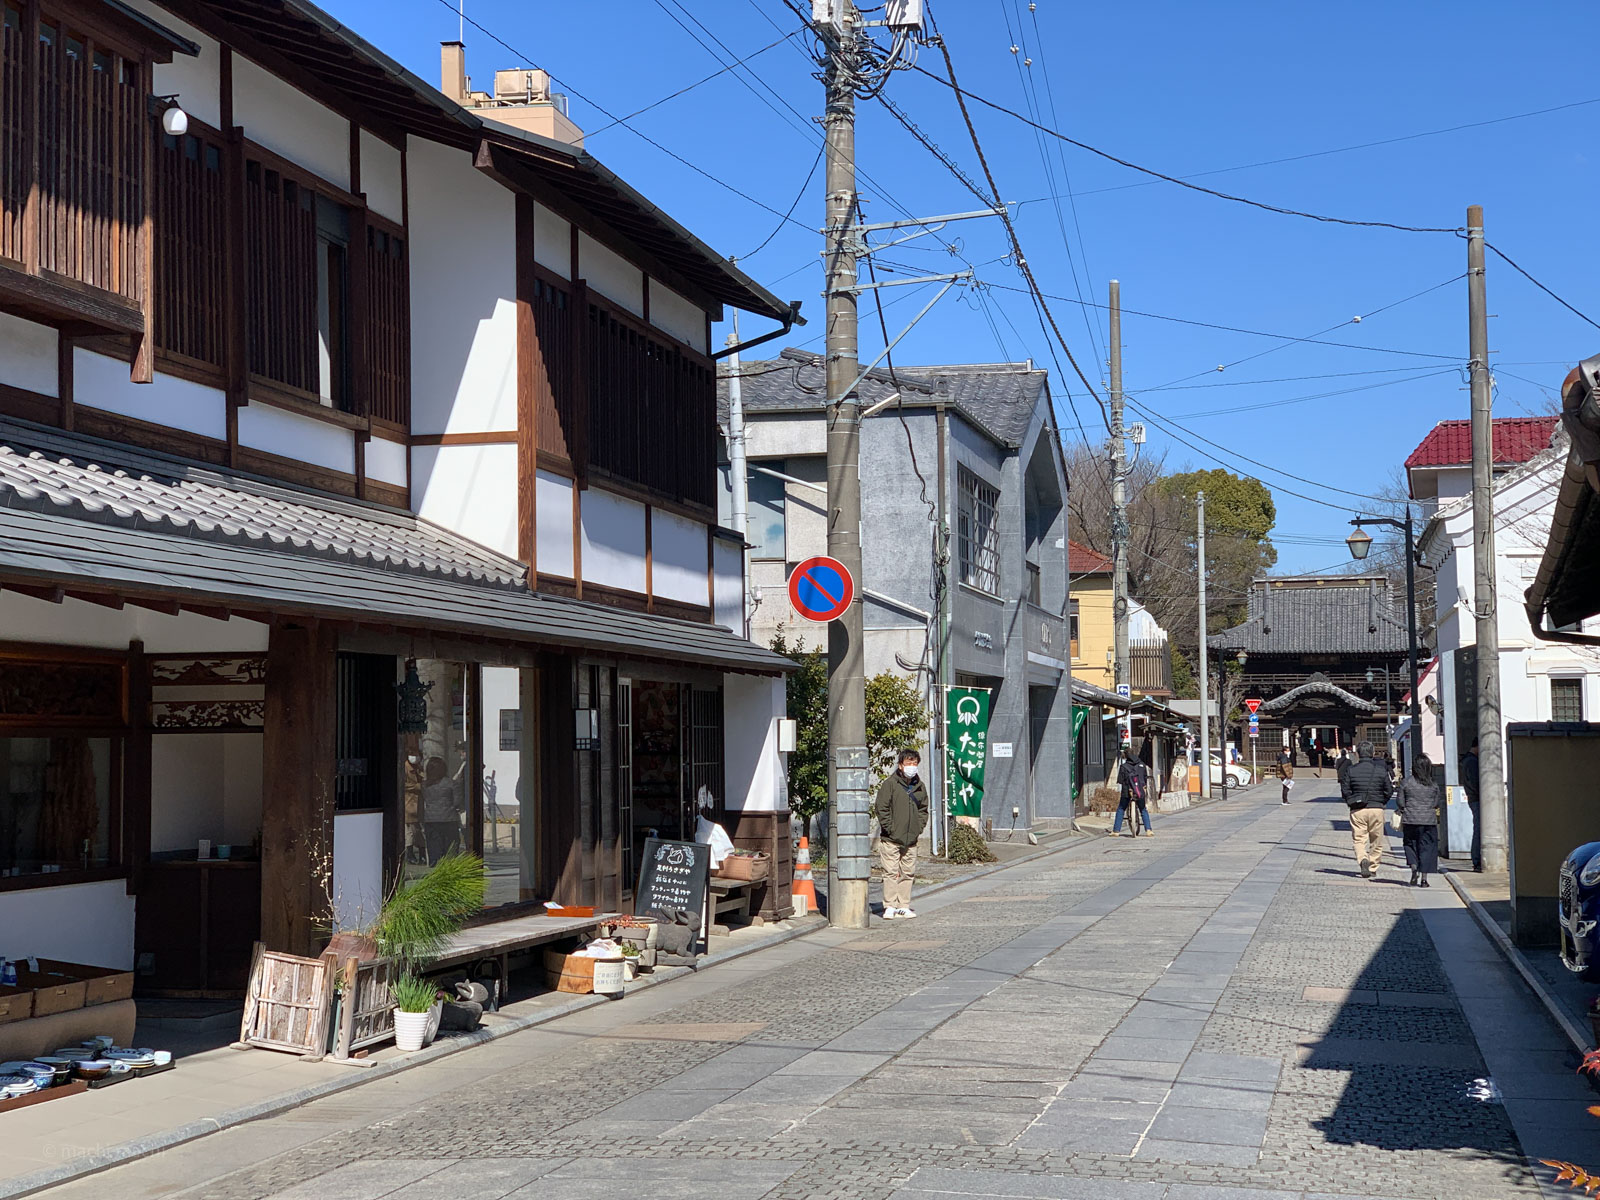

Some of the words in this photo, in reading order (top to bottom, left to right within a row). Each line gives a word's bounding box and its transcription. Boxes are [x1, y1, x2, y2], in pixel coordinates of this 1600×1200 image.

[958, 731, 976, 806] たけや
[656, 864, 691, 875] 足利うさぎや
